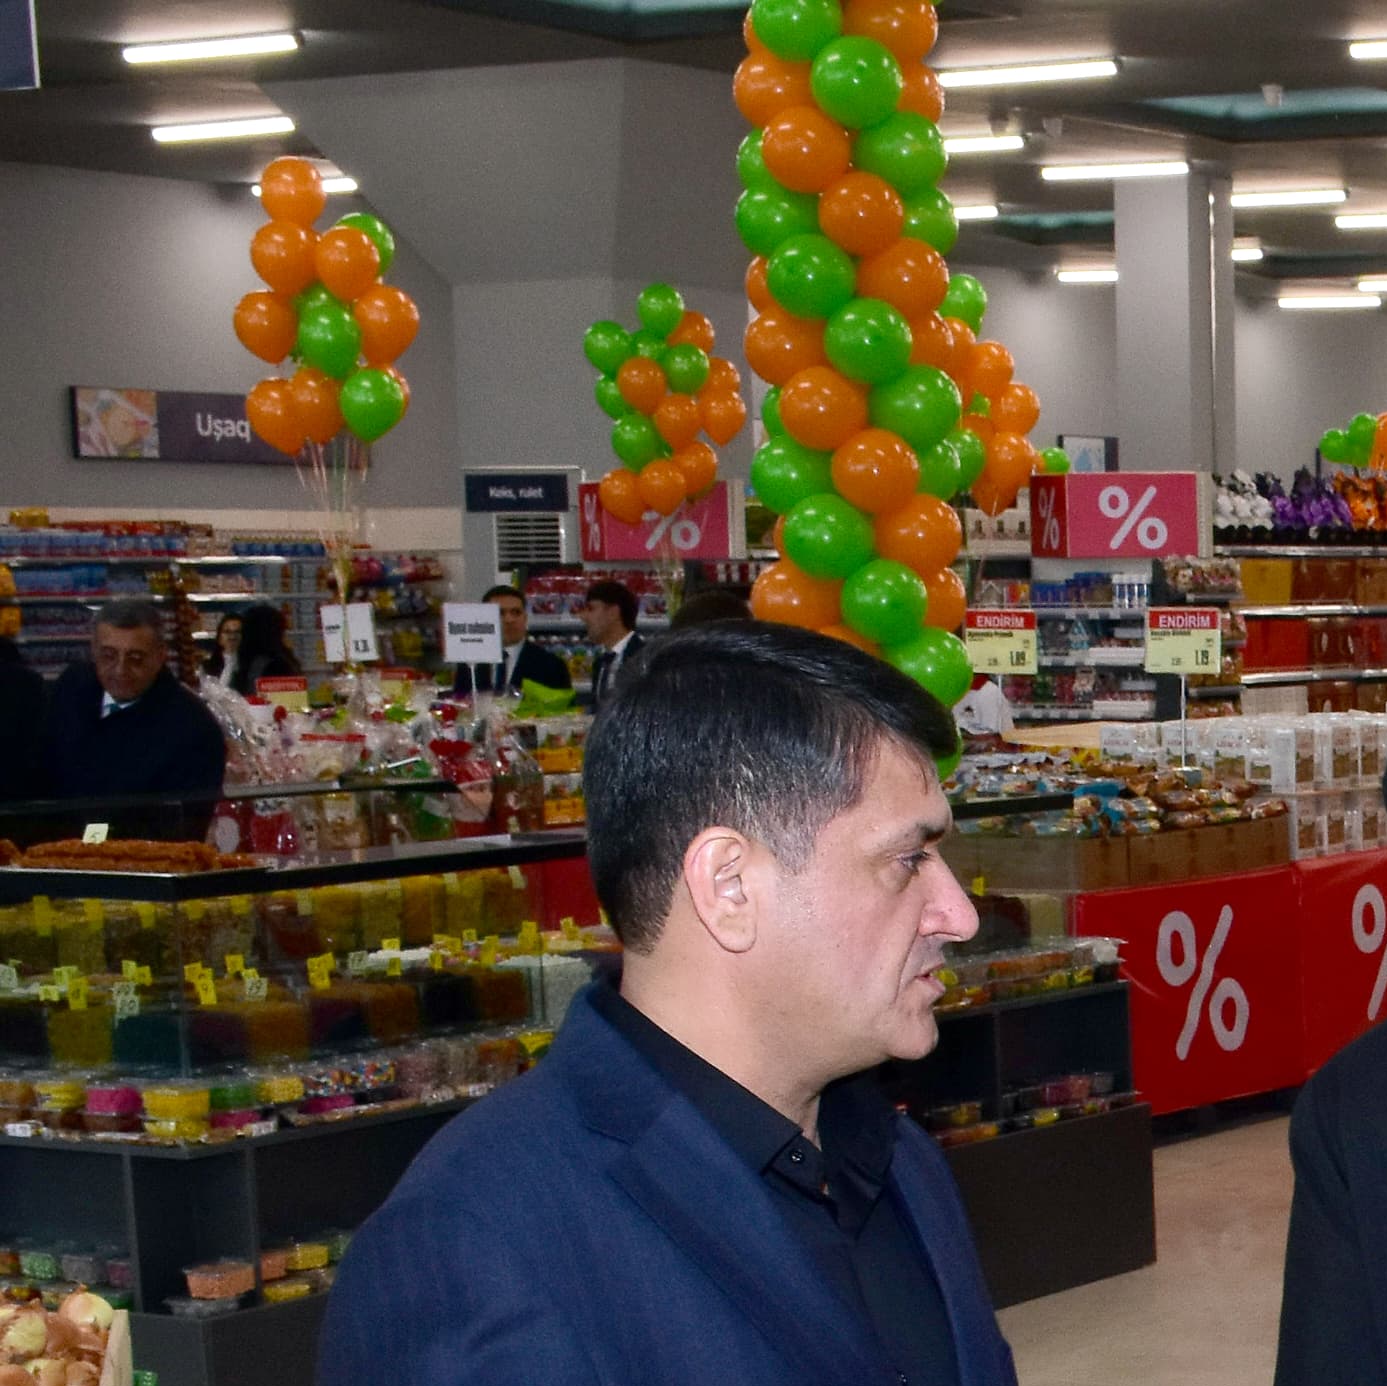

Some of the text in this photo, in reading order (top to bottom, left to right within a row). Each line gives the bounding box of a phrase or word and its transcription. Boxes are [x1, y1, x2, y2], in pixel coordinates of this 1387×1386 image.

[196, 411, 251, 443] Uşaq
[977, 613, 1025, 628] ENDİRİM
[1159, 612, 1210, 628] ENDİRİM
